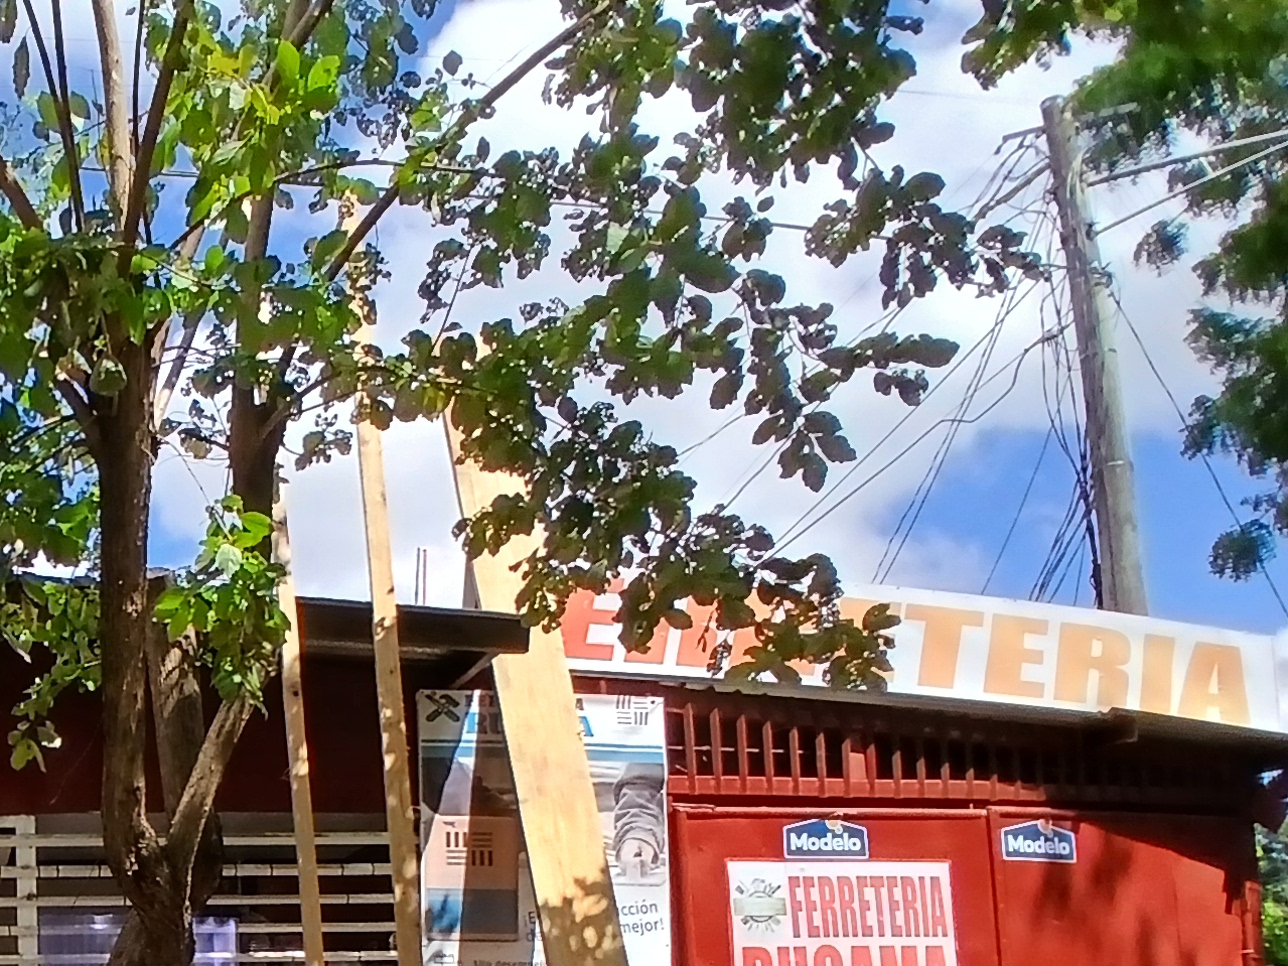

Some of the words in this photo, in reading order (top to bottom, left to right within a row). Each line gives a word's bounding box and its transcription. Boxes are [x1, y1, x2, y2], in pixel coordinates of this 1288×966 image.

[561, 576, 1252, 725] ETERIA
[790, 832, 861, 851] Modelo
[1007, 835, 1070, 855] Modelo
[788, 875, 948, 938] FERRETERIA
